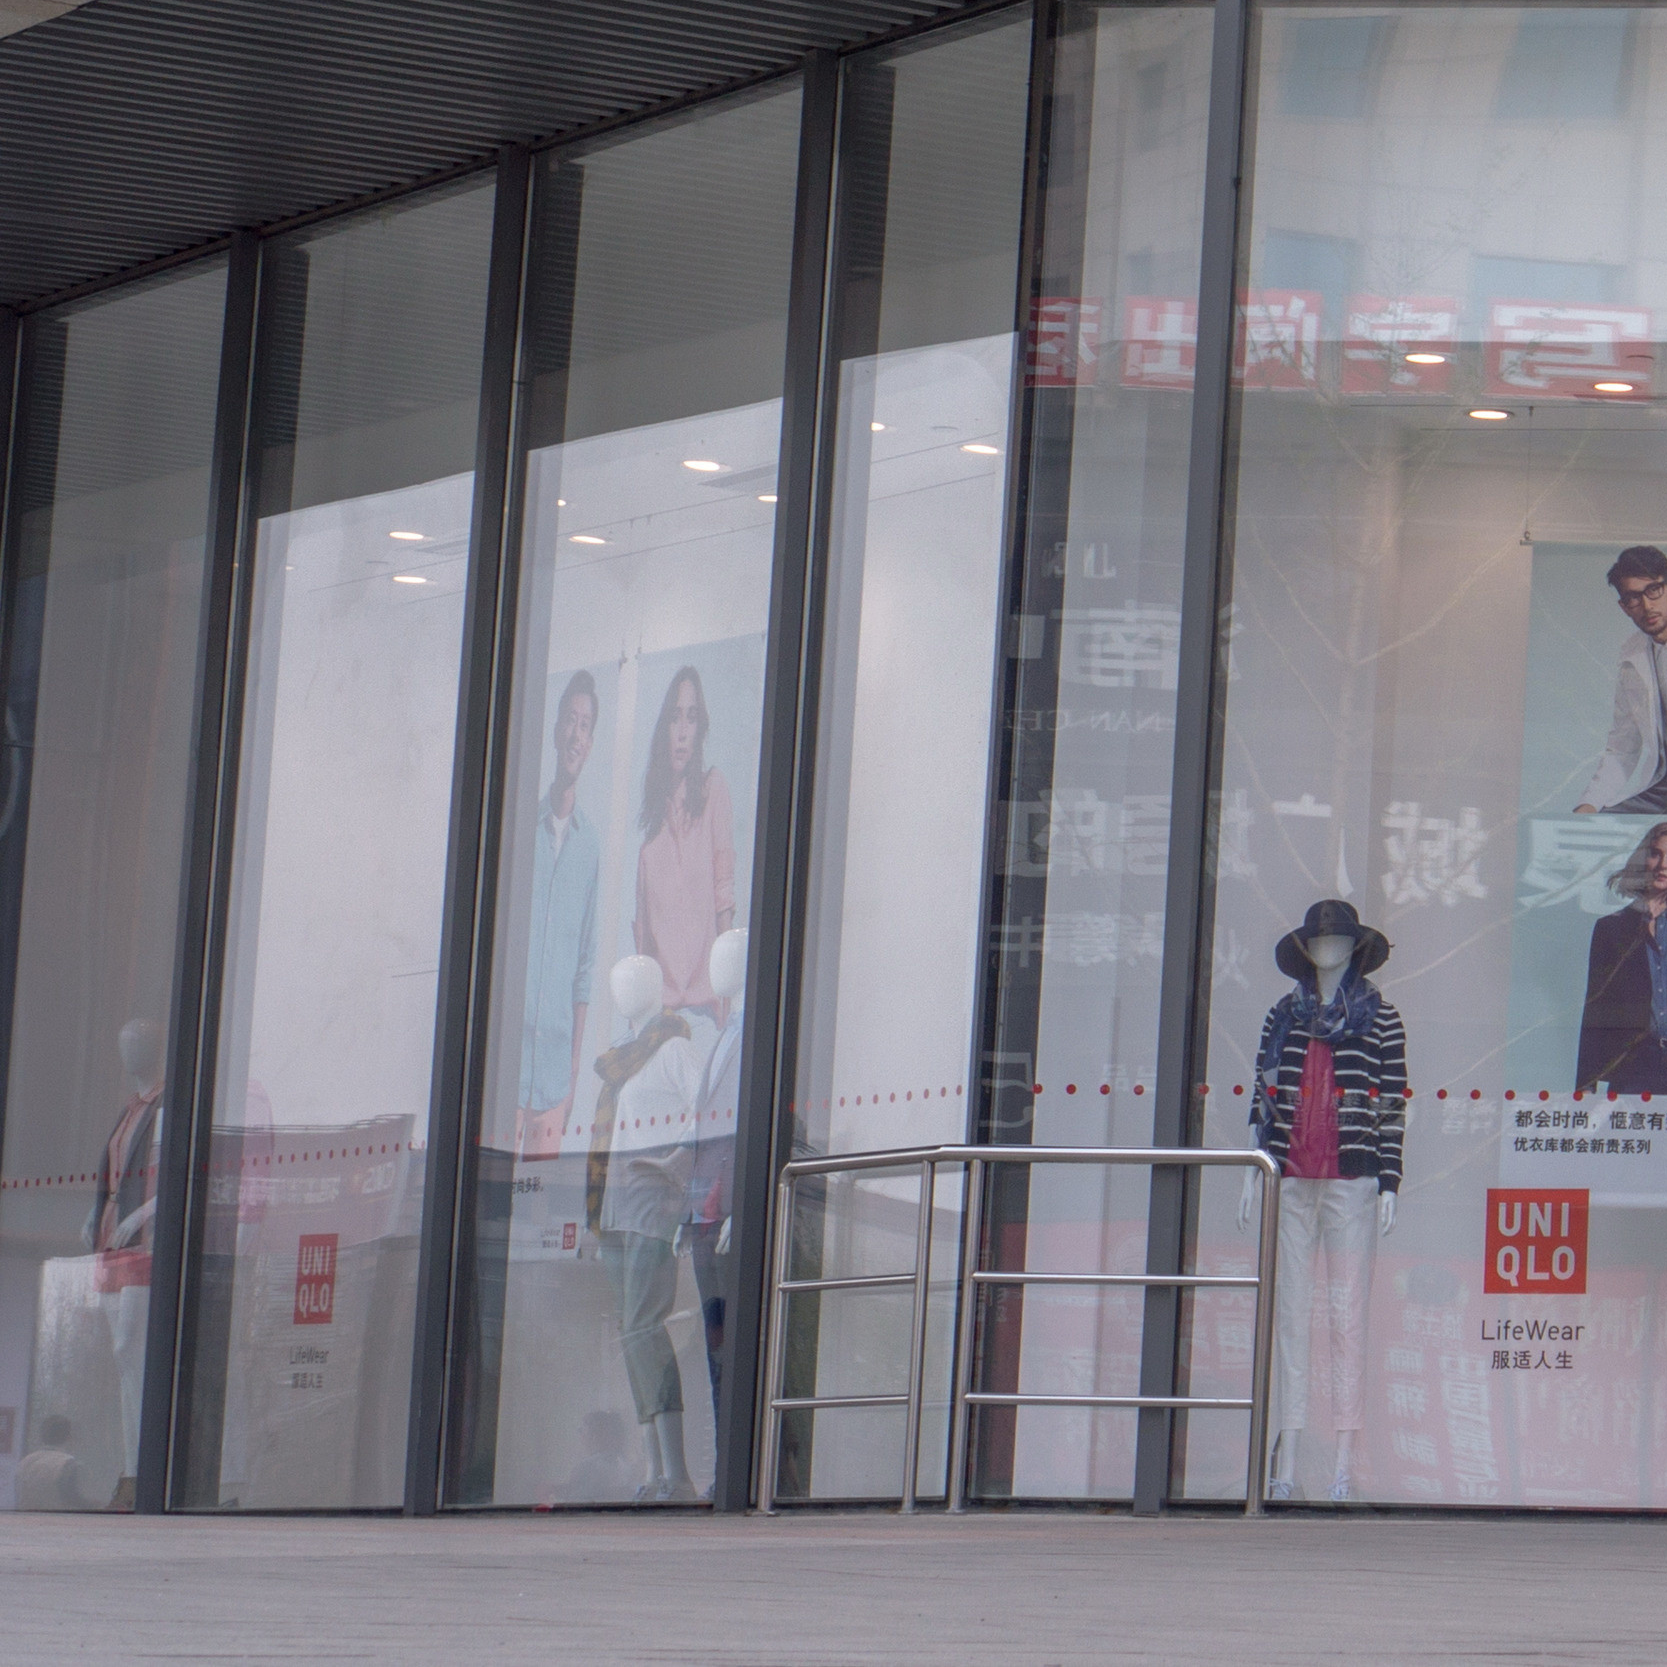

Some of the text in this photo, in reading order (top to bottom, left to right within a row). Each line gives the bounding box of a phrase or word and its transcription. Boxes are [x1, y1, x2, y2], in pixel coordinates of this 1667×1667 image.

[1514, 1136, 1651, 1155] 优衣库都会新贵系列
[1497, 1202, 1570, 1238] UNI
[301, 1245, 331, 1276] UNI
[1496, 1245, 1576, 1287] QLO
[299, 1282, 331, 1319] QLO
[1481, 1319, 1586, 1341] LifeWear
[1491, 1349, 1574, 1370] 服适人生
